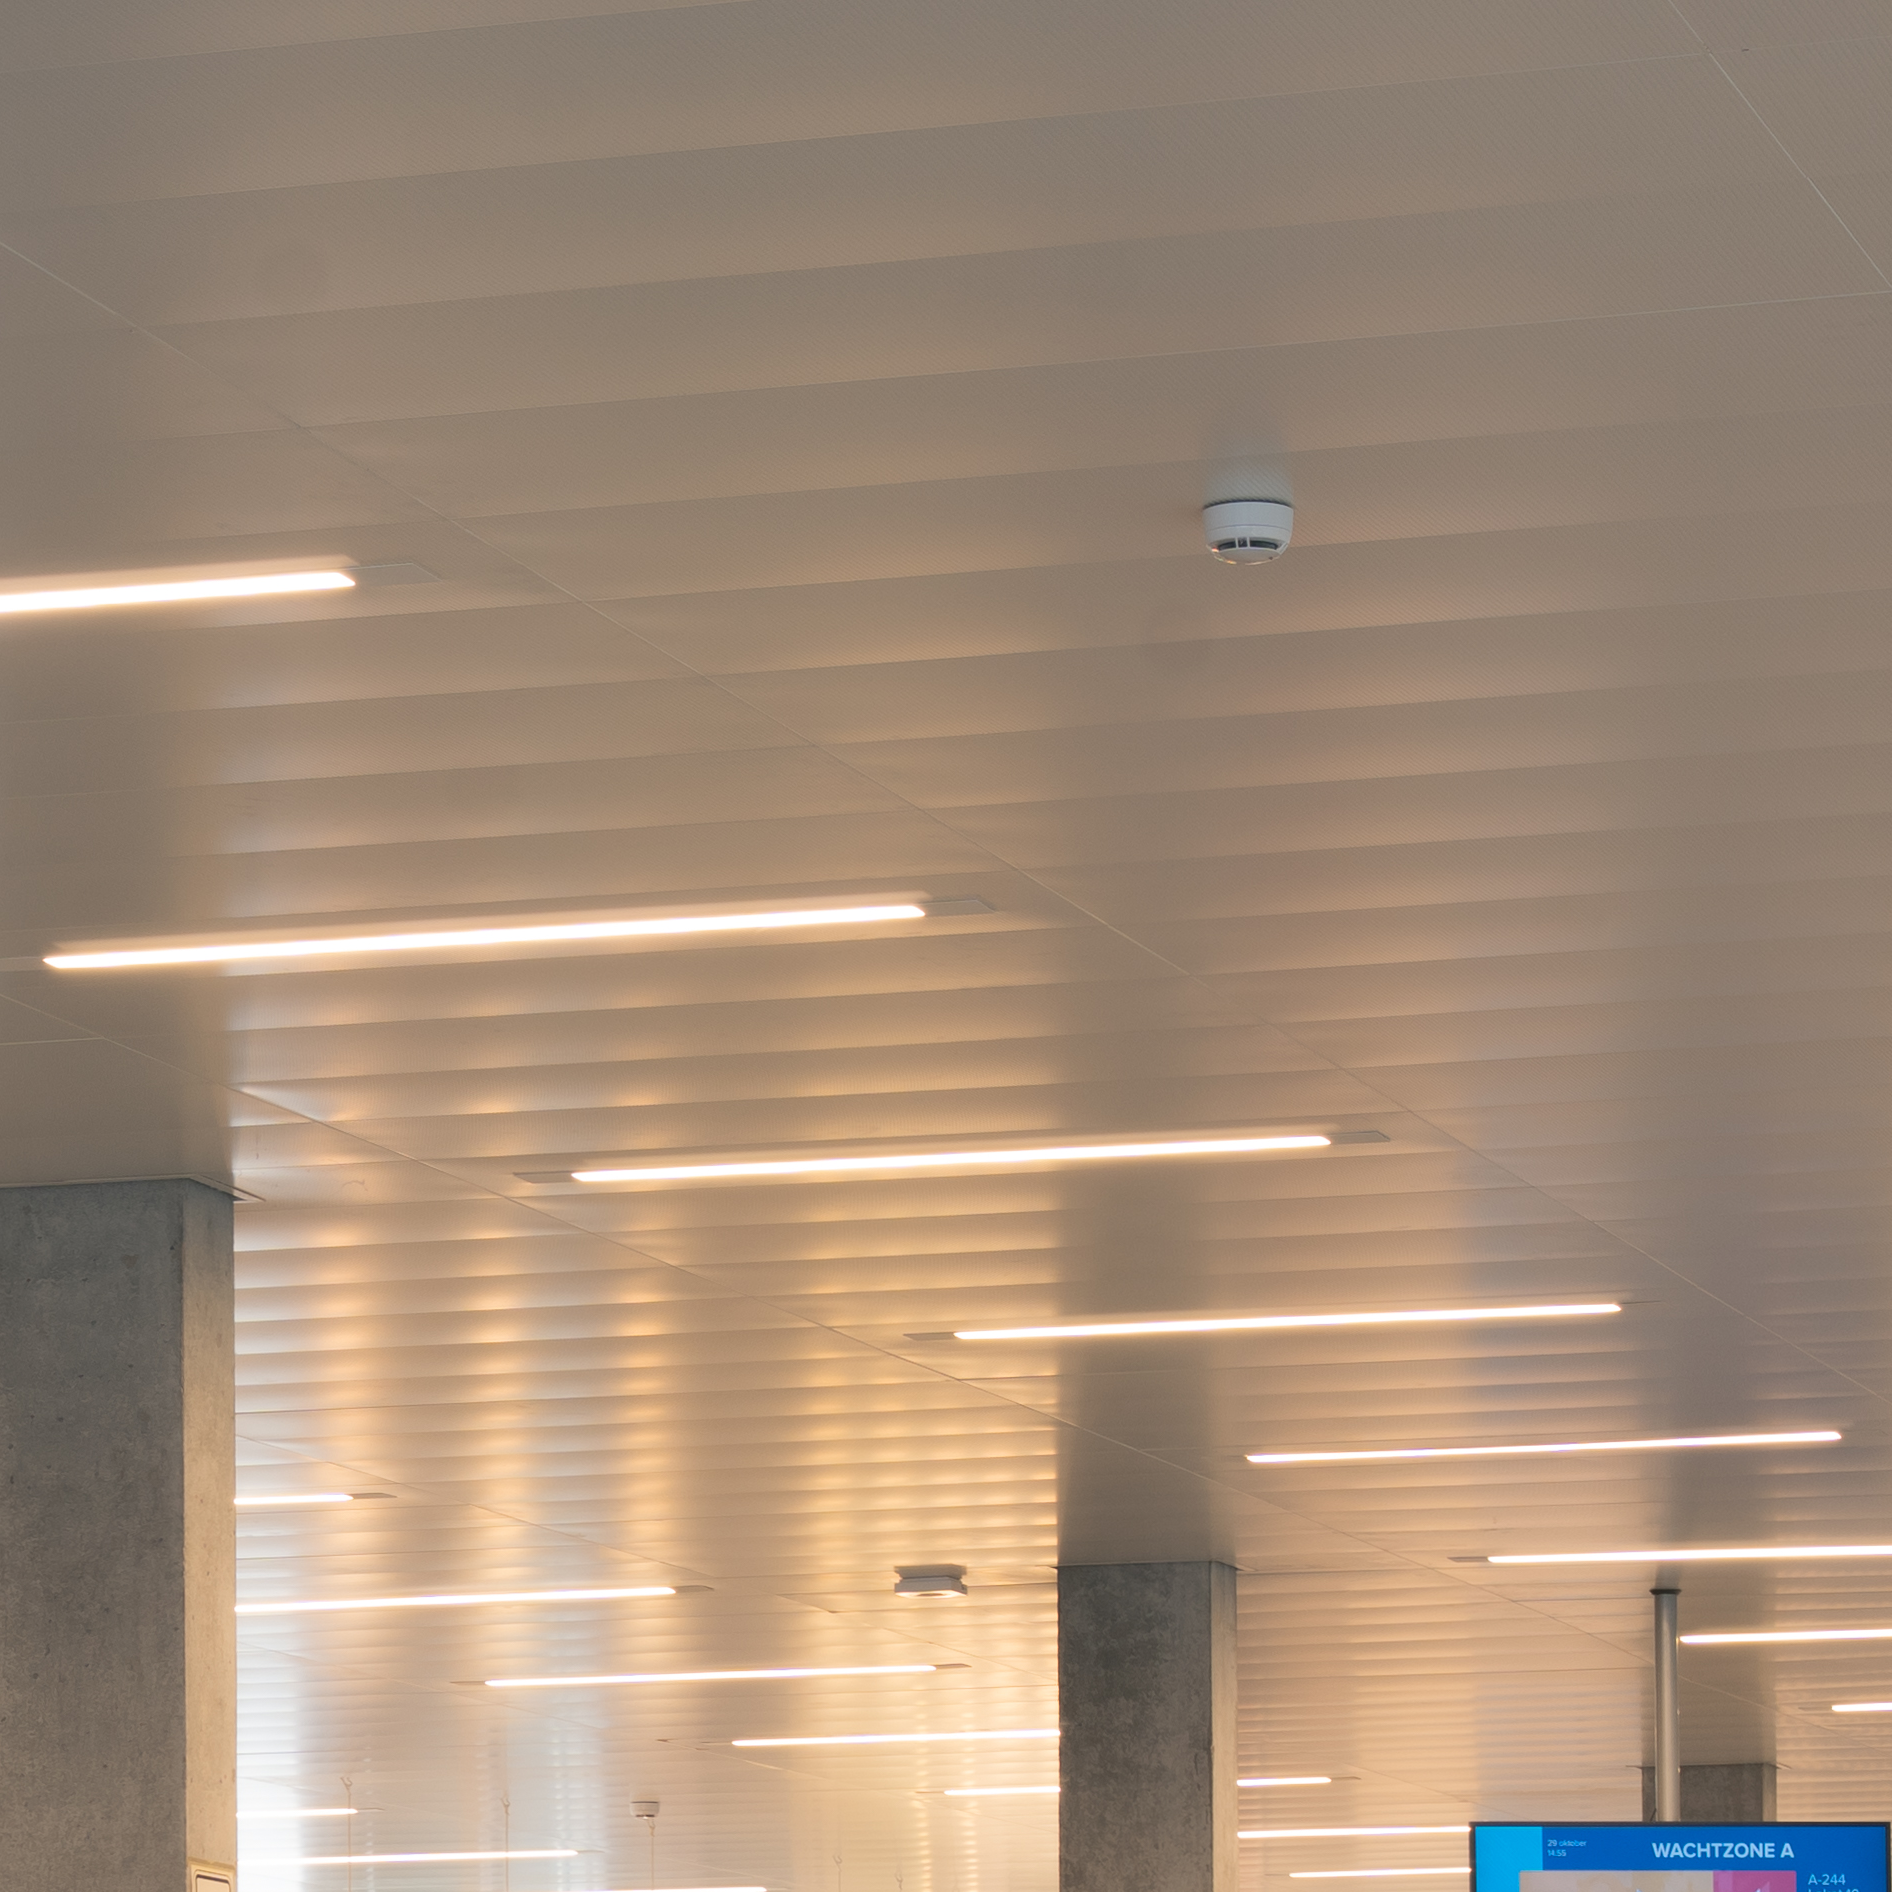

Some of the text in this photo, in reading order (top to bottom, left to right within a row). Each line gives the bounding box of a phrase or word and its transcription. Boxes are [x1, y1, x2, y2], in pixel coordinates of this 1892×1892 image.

[1547, 1839, 1587, 1847] 29 oktober
[1652, 1842, 1795, 1858] WACHTZONE A
[1808, 1874, 1846, 1886] A-244
